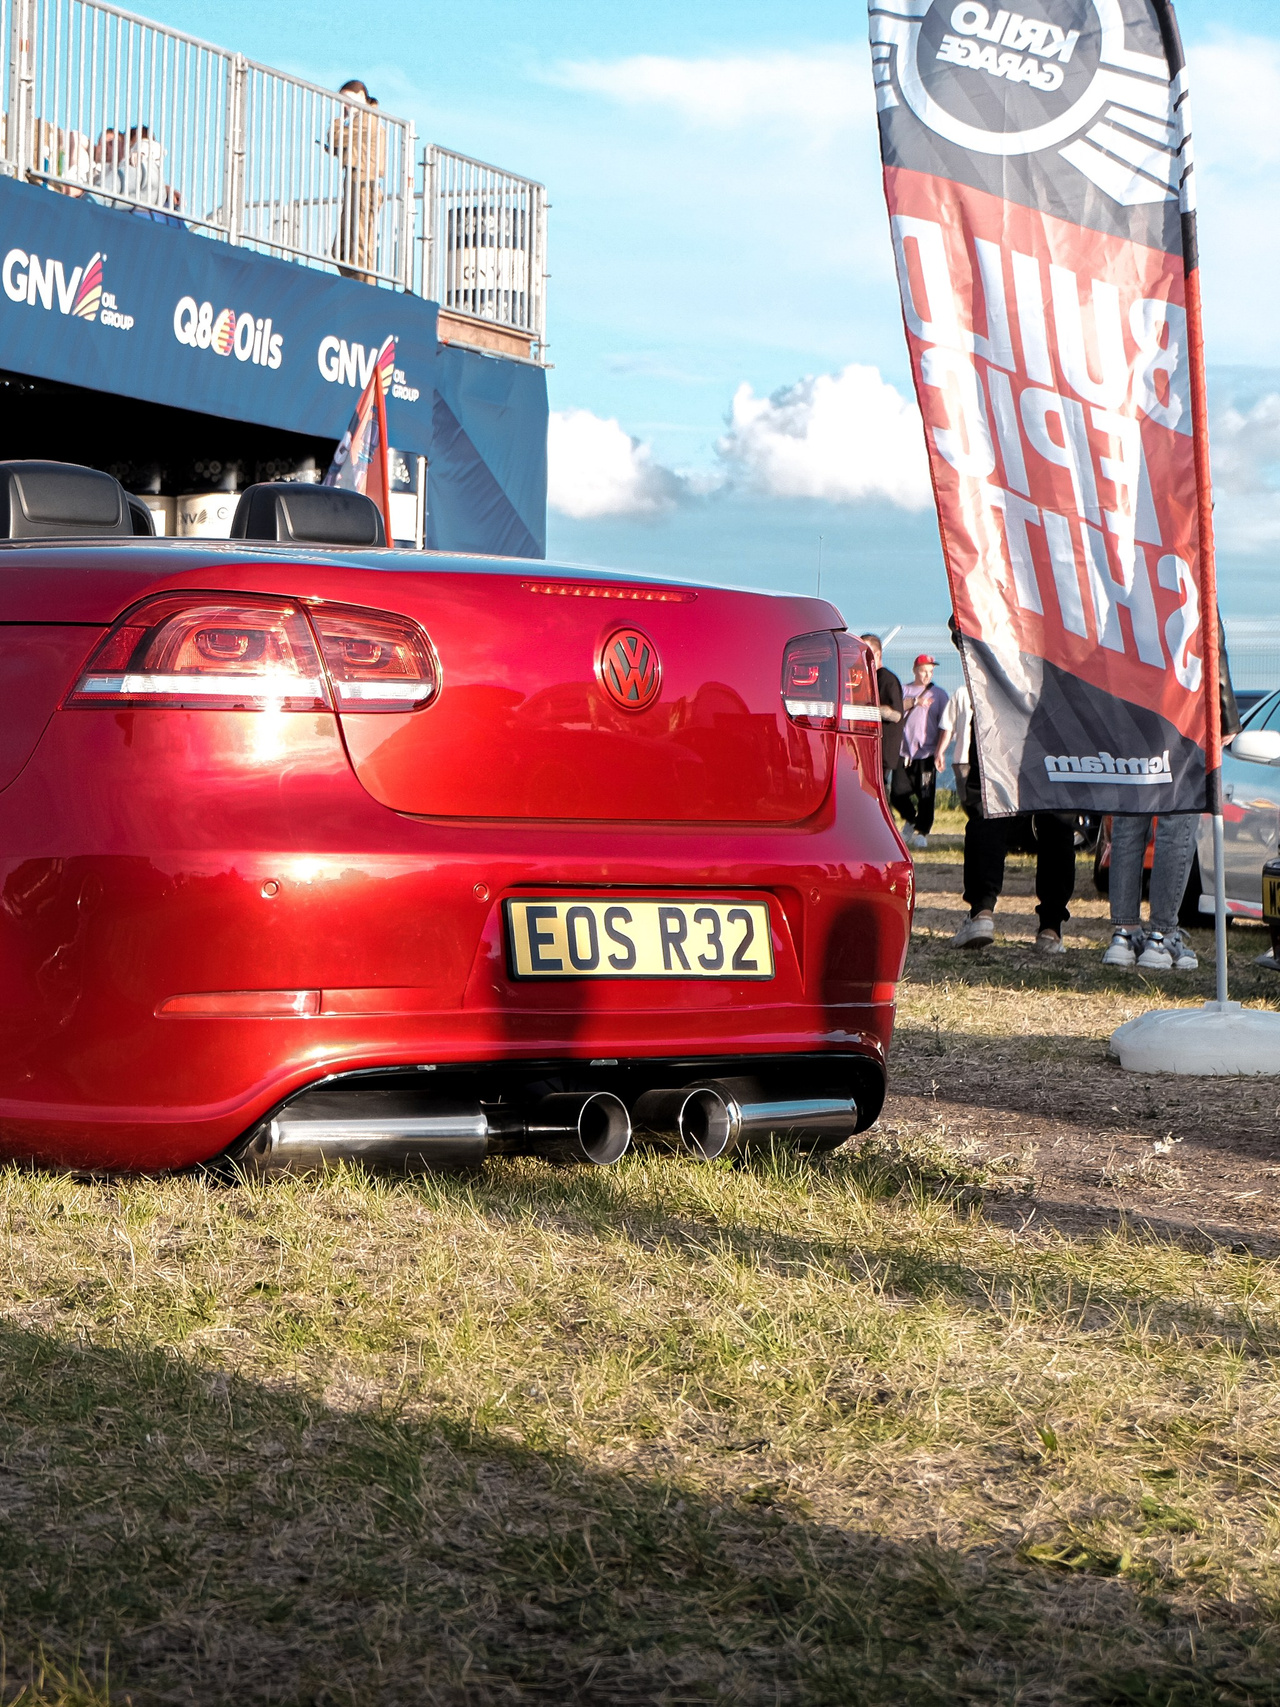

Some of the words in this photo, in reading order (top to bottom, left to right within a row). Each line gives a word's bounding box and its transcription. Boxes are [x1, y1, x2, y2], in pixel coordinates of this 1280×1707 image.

[2, 248, 83, 315] GNV
[101, 292, 118, 310] OIL
[101, 309, 135, 331] GROUP
[173, 296, 213, 349] Q8
[234, 312, 283, 370] Oils
[318, 335, 379, 391] GNV
[393, 369, 407, 385] OIL
[392, 384, 420, 402] GROUP
[525, 906, 637, 971] EOS
[657, 906, 758, 971] R32
